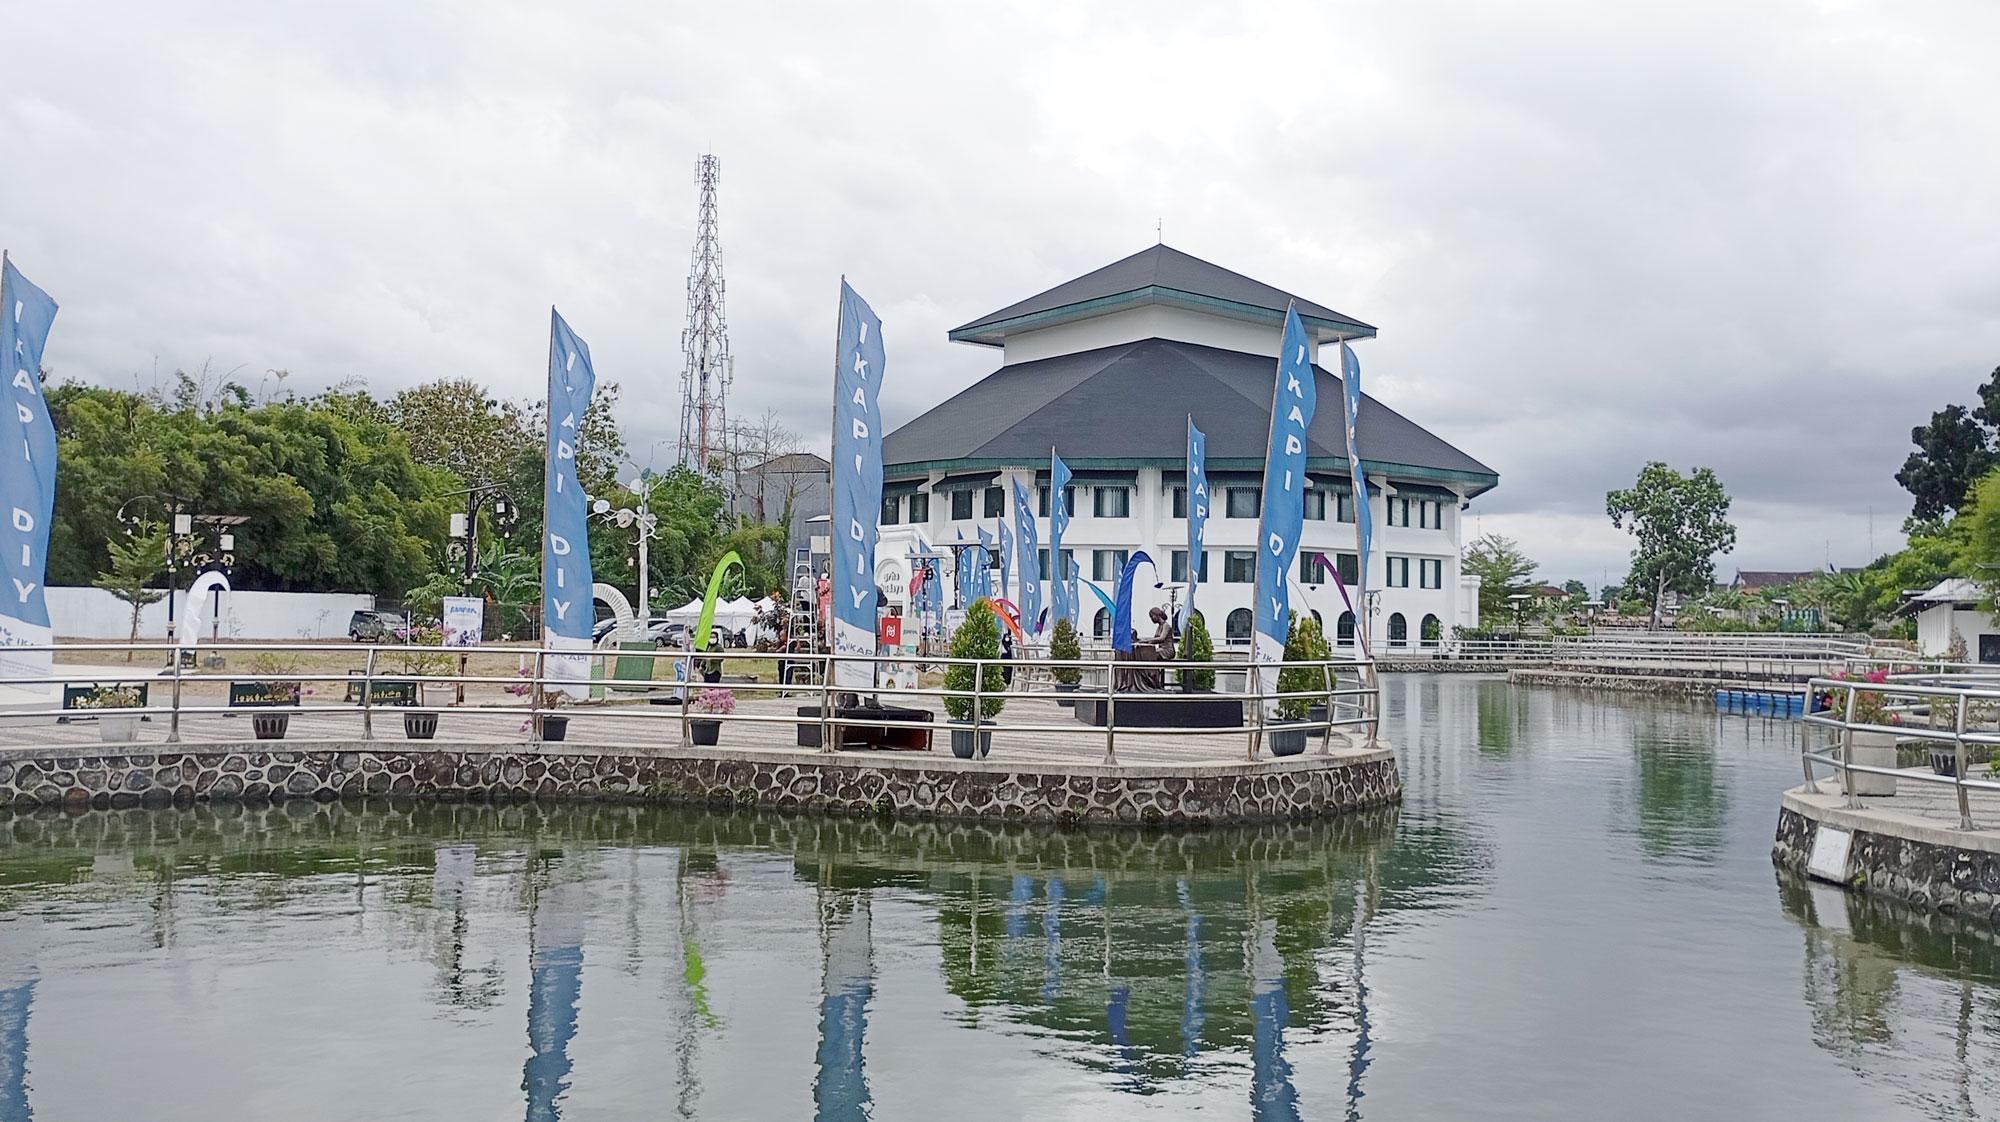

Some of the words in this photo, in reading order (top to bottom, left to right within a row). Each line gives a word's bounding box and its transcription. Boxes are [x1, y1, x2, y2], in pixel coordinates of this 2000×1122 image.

[557, 351, 576, 494] IAPI
[853, 321, 870, 476] IKAPI
[1284, 344, 1305, 492] IKAPI
[12, 506, 36, 603] DIY
[550, 533, 571, 620] DIY
[851, 517, 868, 609] DIY
[1269, 531, 1285, 621] DIY
[845, 642, 874, 656] IKAP
